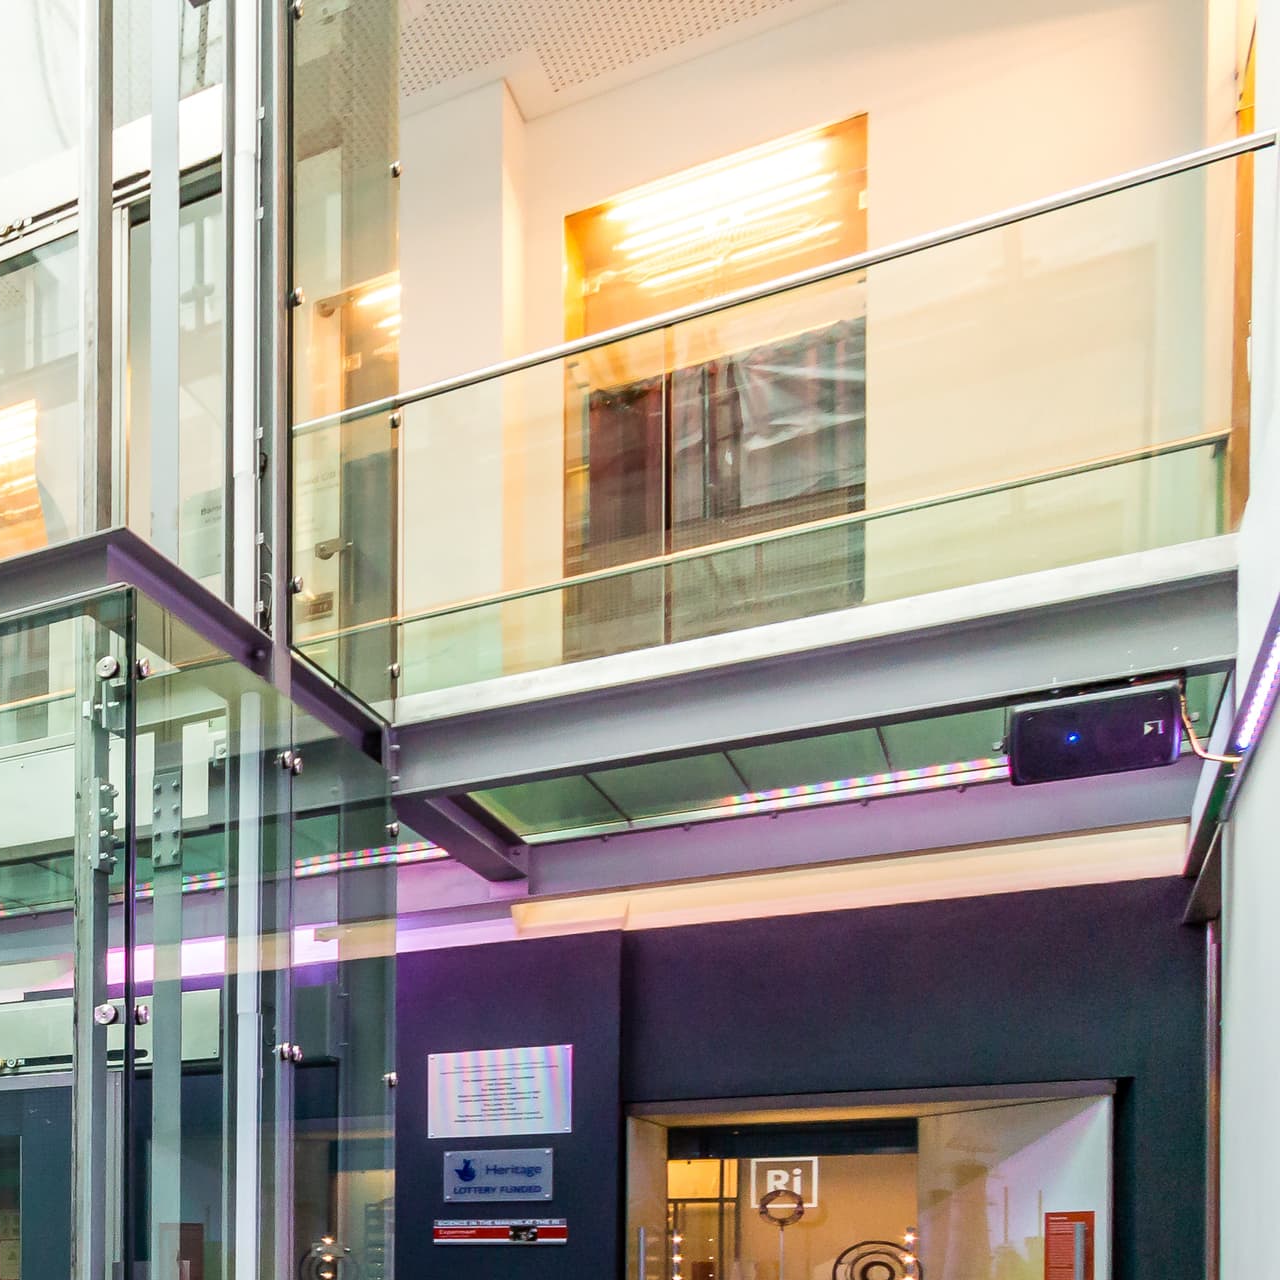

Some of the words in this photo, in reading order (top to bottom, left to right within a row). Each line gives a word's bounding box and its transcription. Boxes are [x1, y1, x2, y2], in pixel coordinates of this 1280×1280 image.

[486, 1165, 542, 1177] Heritage
[767, 1168, 802, 1196] Ri
[453, 1186, 496, 1194] LOTTERY
[500, 1185, 542, 1193] FUNDED
